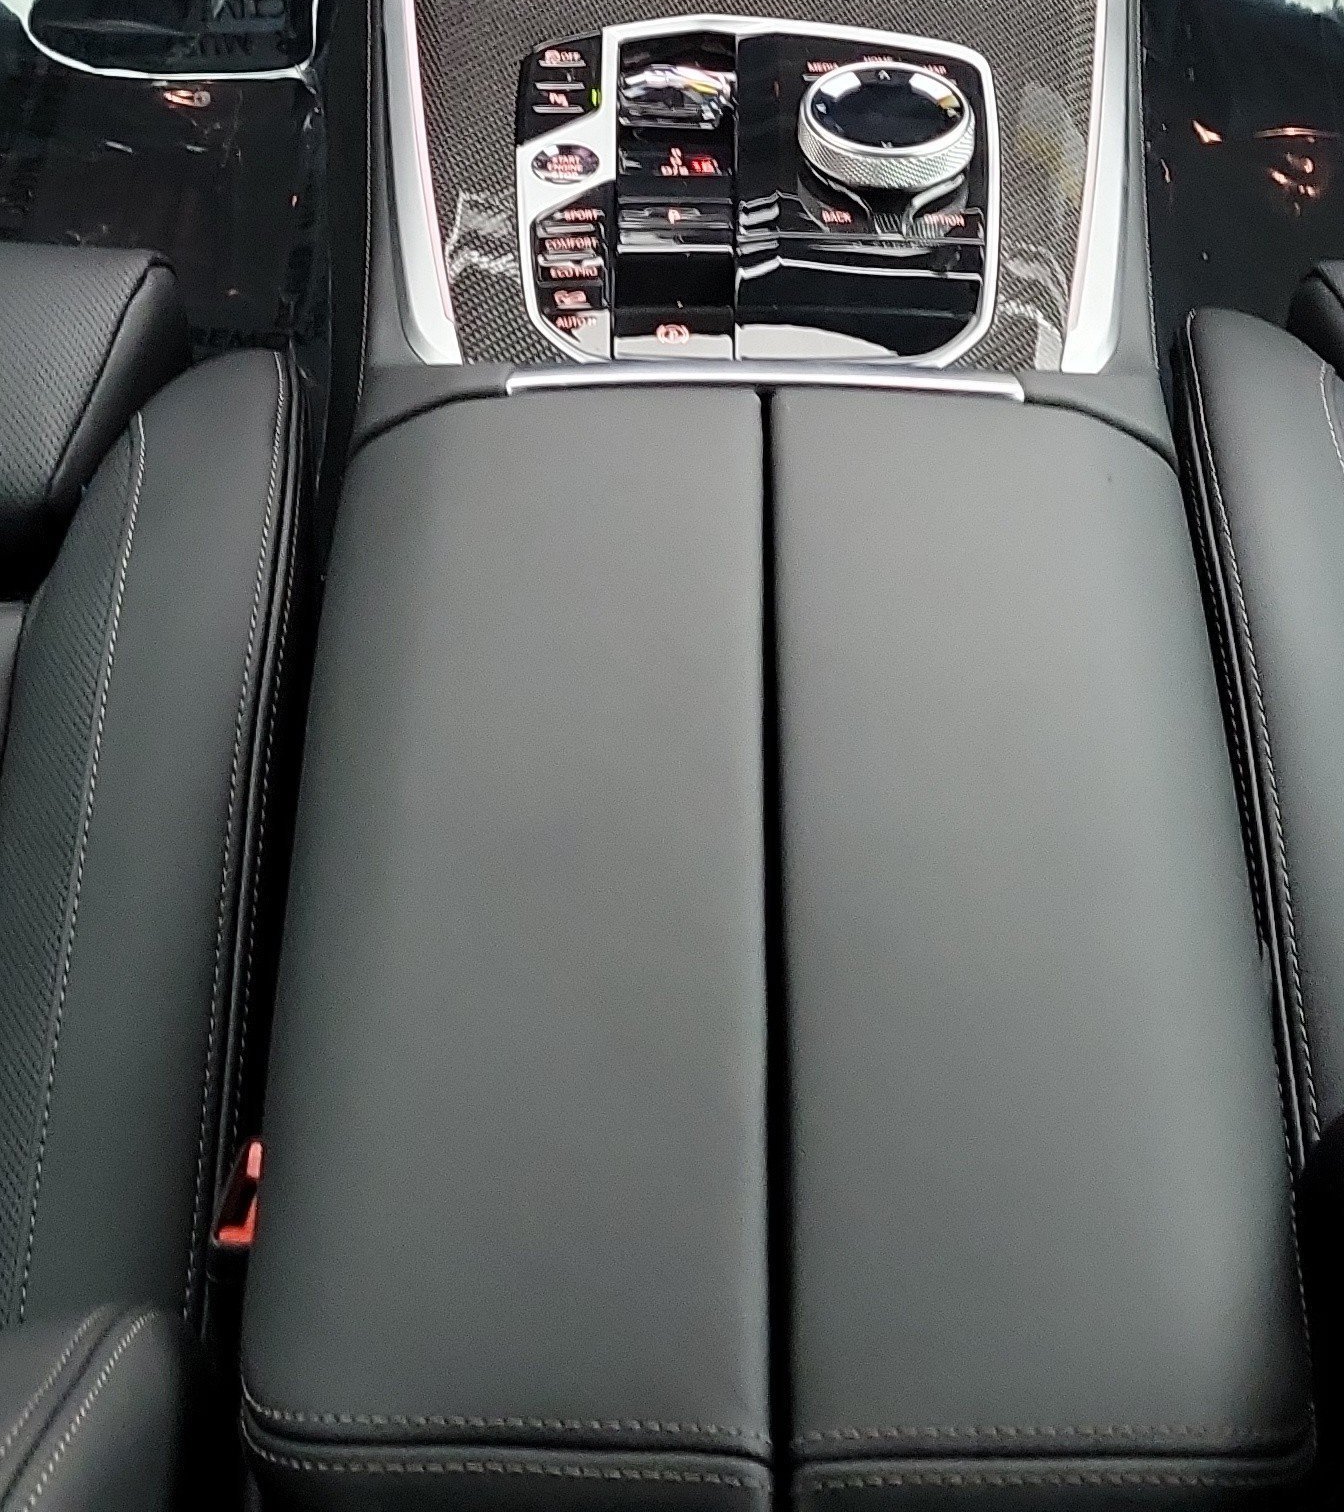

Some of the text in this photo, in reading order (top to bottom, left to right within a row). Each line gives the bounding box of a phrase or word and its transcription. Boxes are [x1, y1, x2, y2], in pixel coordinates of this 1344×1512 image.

[552, 155, 581, 164] START
[564, 209, 598, 221] SPORT
[668, 209, 681, 225] P
[822, 210, 852, 223] BACK
[923, 213, 965, 227] OPTION
[545, 237, 599, 250] COMFORT
[557, 316, 586, 328] AUTO
